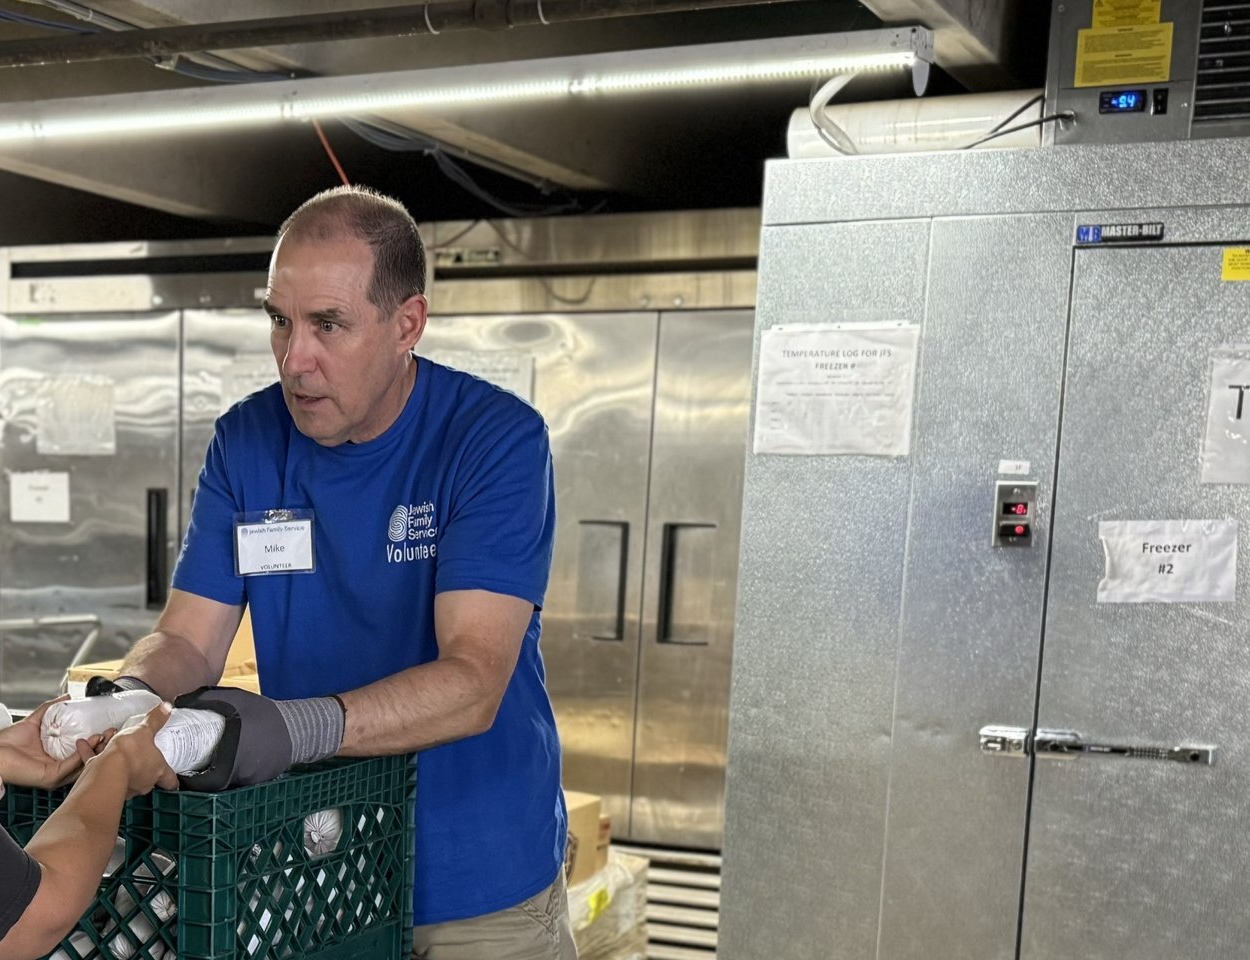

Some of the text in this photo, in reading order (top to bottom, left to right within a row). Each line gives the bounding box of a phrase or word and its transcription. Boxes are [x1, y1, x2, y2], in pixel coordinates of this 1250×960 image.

[1101, 223, 1163, 238] MASTER-BILT
[782, 350, 841, 358] TEMPERATURE
[842, 350, 859, 358] LOG
[861, 350, 878, 358] FOR
[408, 501, 435, 515] Jewish
[264, 543, 285, 553] Mike
[386, 541, 437, 563] Voluntee
[1142, 542, 1192, 554] Freezer
[1157, 563, 1175, 575] #2
